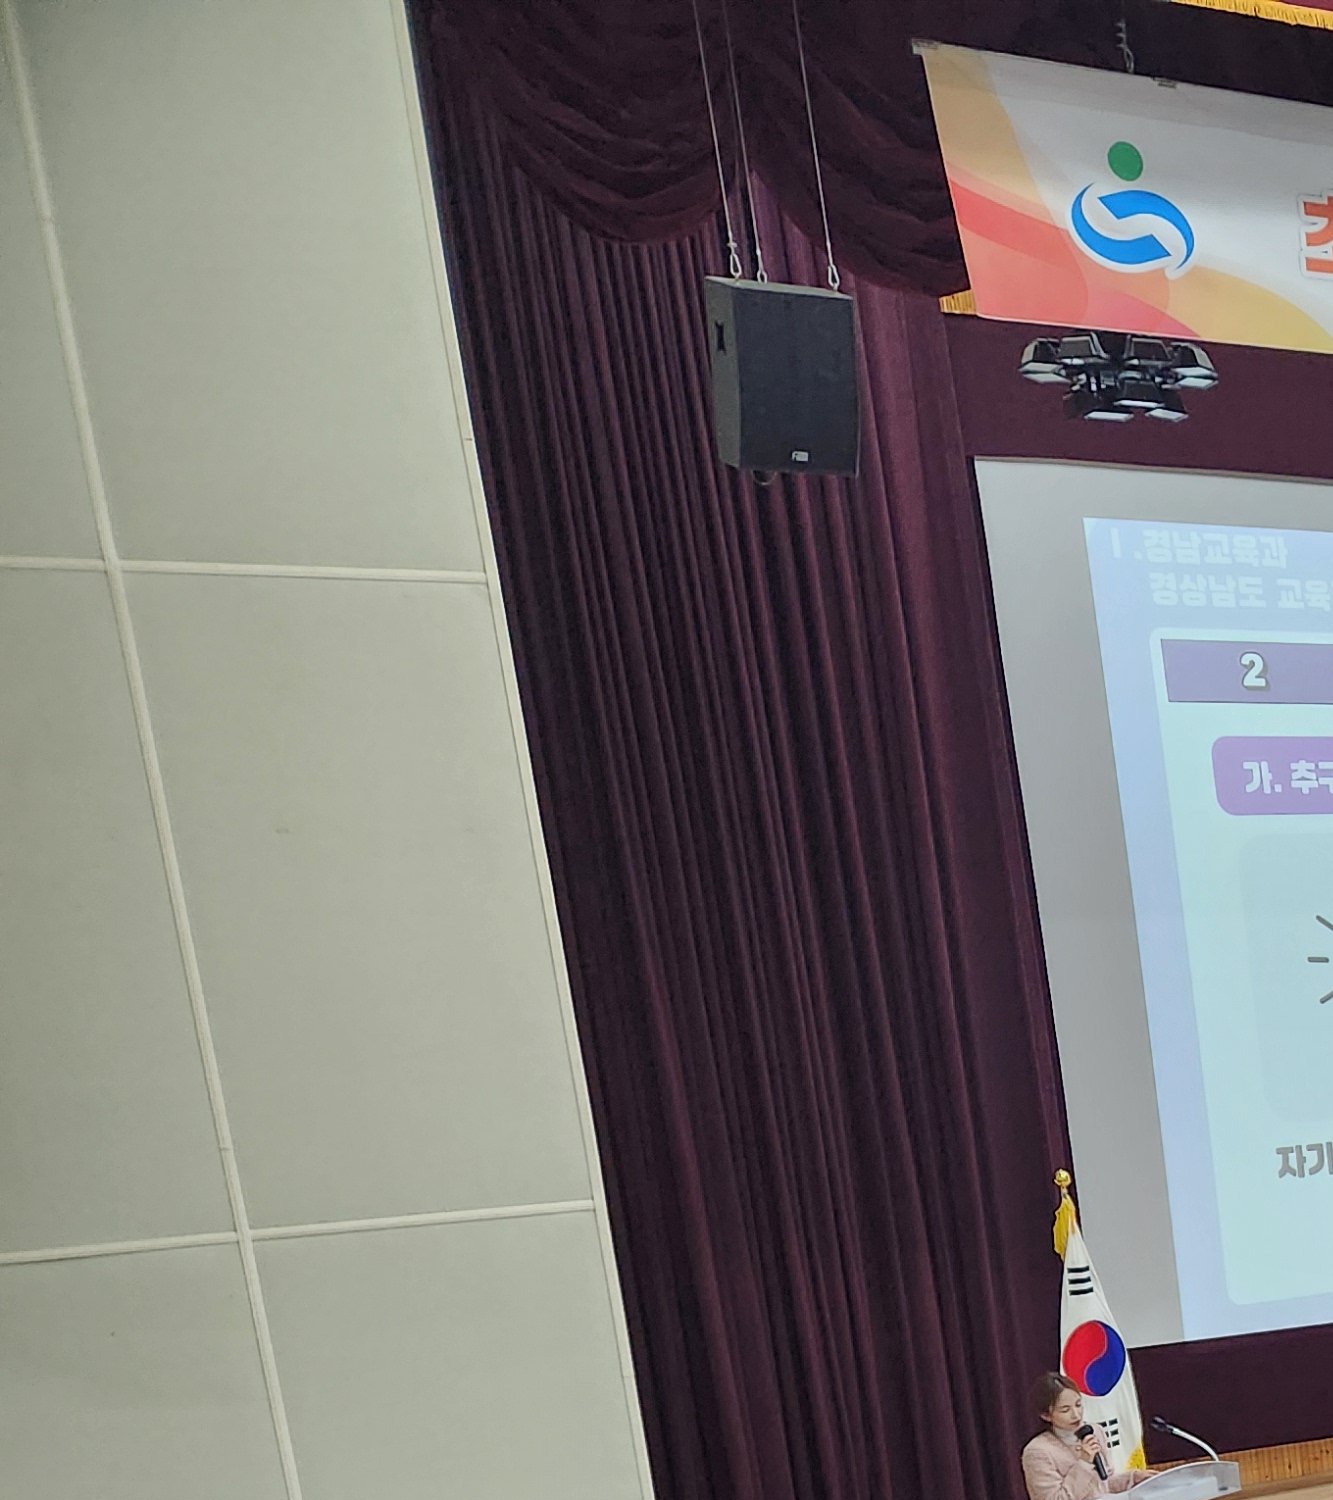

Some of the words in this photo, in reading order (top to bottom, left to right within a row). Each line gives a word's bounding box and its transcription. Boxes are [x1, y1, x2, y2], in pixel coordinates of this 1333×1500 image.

[1143, 528, 1288, 569] 경남교육과
[1148, 572, 1267, 608] 경상남도
[1239, 652, 1269, 691] 2
[1242, 760, 1282, 794] 가.
